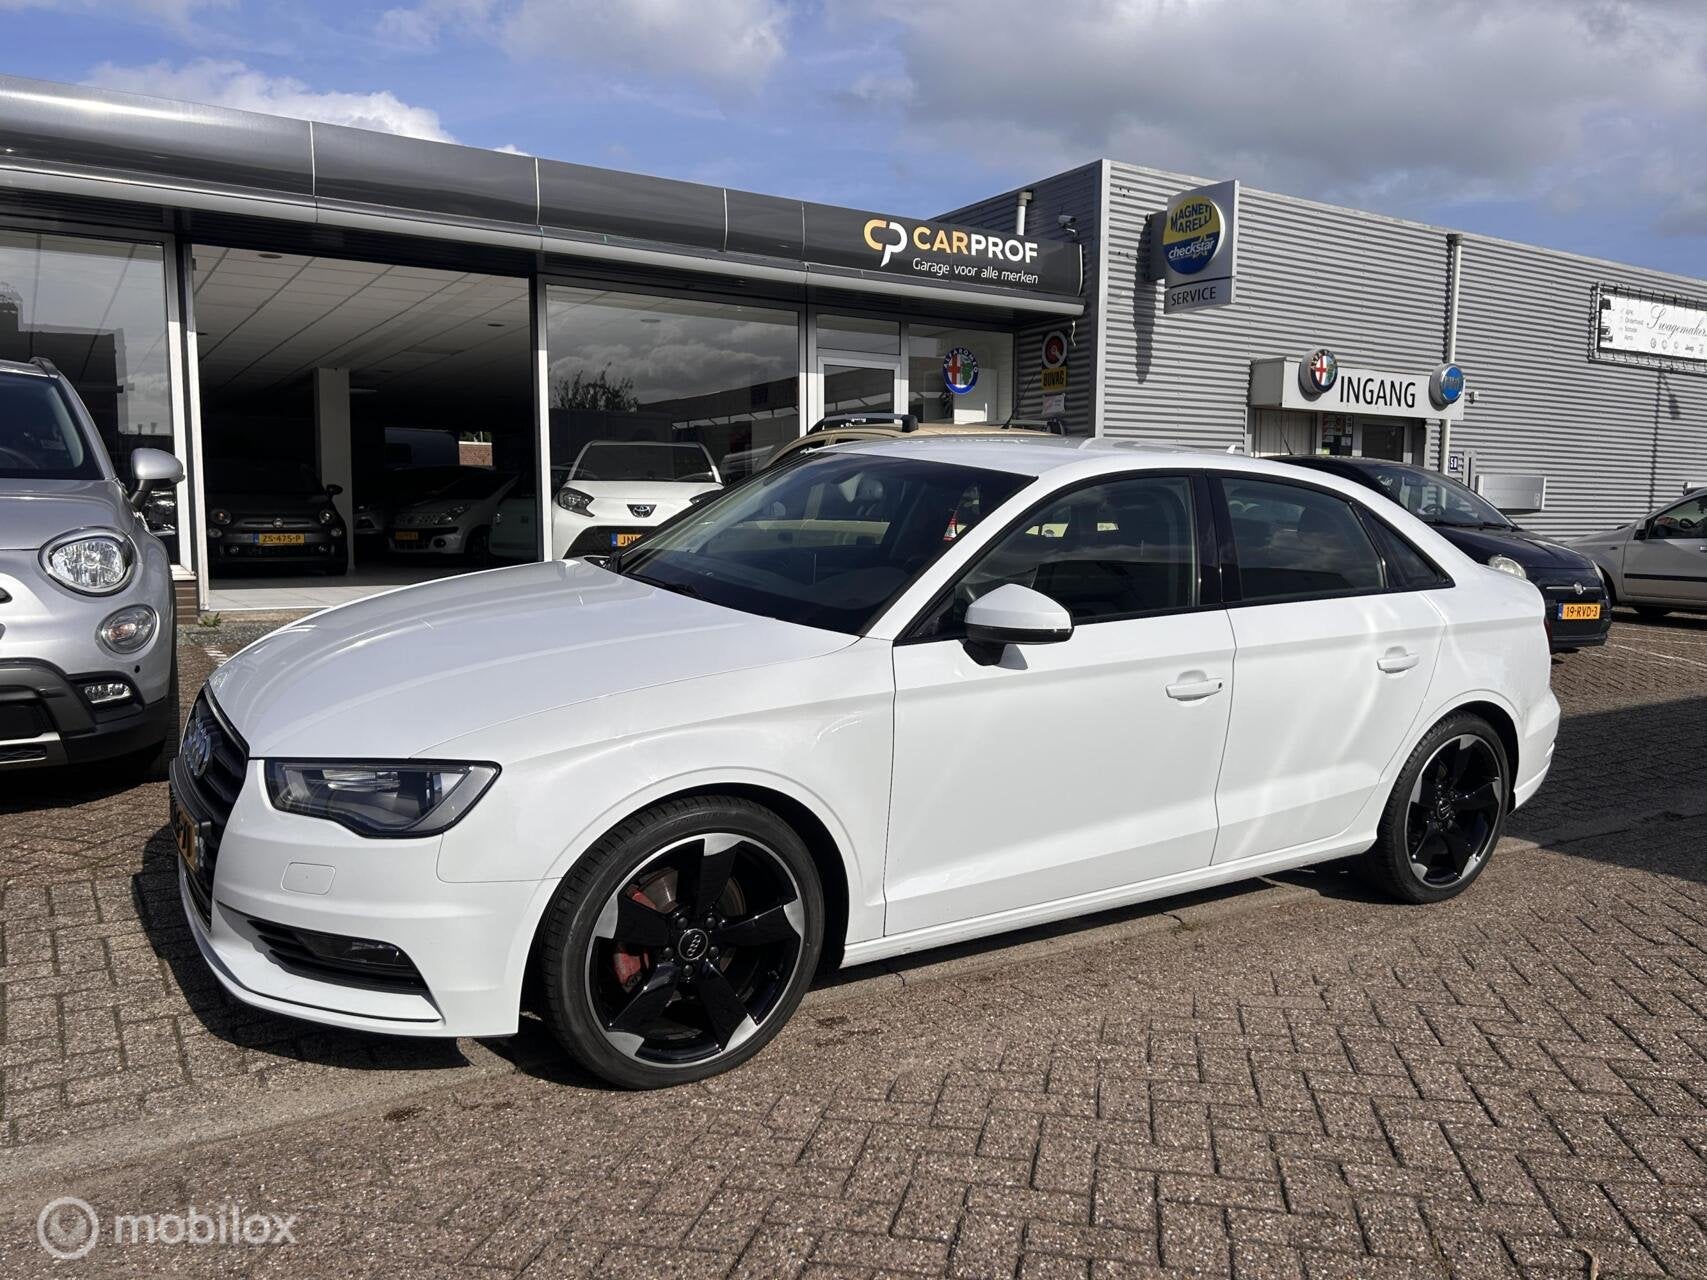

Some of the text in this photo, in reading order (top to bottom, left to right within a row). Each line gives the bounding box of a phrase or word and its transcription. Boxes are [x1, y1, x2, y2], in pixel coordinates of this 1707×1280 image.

[1170, 204, 1212, 231] MAGNETI
[913, 226, 1038, 264] CARPROF
[1168, 239, 1215, 259] checkstar
[912, 257, 1039, 285] Garage voor alle merken
[1171, 286, 1217, 306] SERVICE
[1339, 375, 1416, 408] INGANG
[1566, 605, 1598, 618] 19-RVD-3
